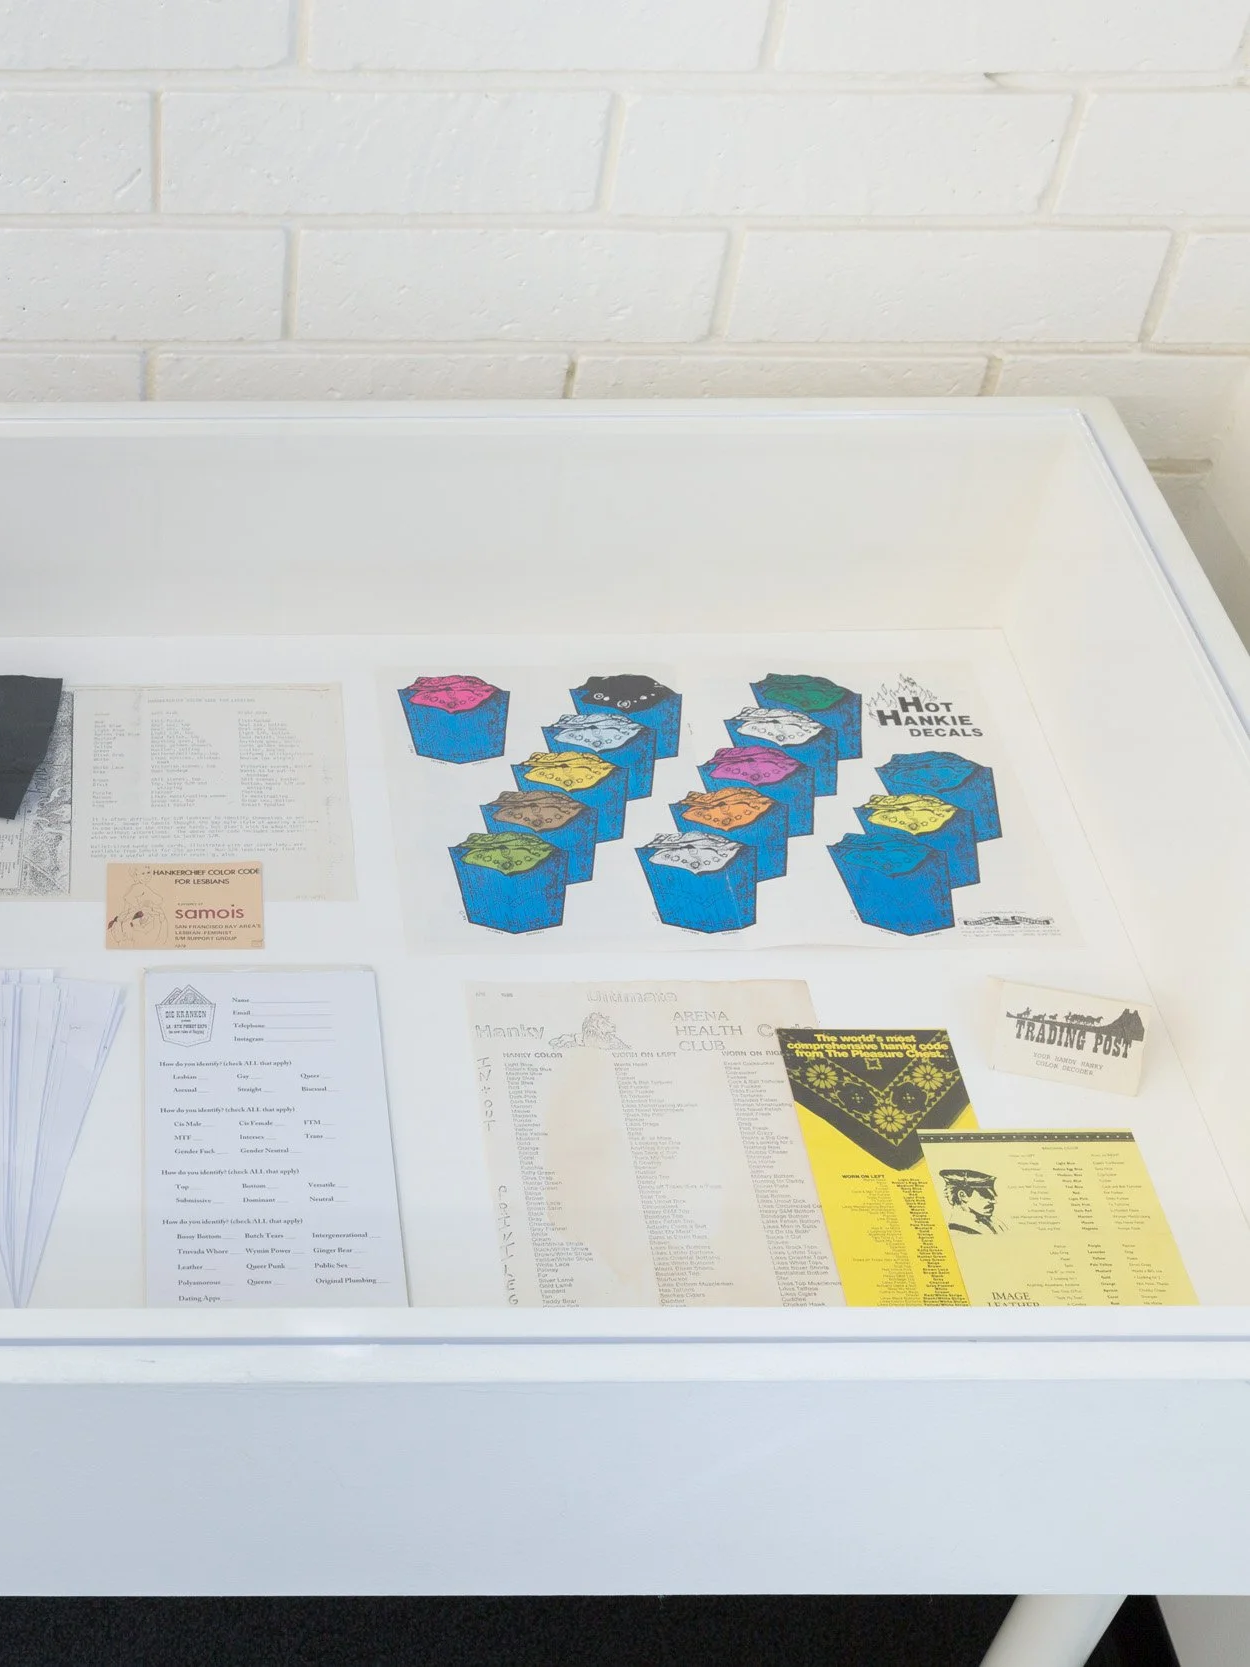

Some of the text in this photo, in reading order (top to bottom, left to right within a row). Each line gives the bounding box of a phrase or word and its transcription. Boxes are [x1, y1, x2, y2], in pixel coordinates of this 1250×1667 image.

[898, 696, 953, 713] HOT
[877, 709, 973, 726] HANKIE
[909, 728, 984, 737] DECALS
[175, 904, 245, 920] samois
[672, 1011, 729, 1022] ARENA
[475, 1023, 546, 1040] Hanky
[675, 1025, 743, 1036] HEALTH
[814, 1033, 917, 1042] The world's most
[1015, 1019, 1132, 1059] TRADING POST
[678, 1040, 726, 1051] CLUB
[786, 1042, 949, 1051] comprehensive hanky code
[795, 1049, 945, 1058] from The Pleasure Chest.
[273, 1060, 292, 1068] apply)
[237, 1086, 262, 1094] Straight
[178, 1279, 221, 1287] Polyamorous
[315, 1277, 377, 1285] Original Plumbing
[991, 1292, 1031, 1301] IMAGE
